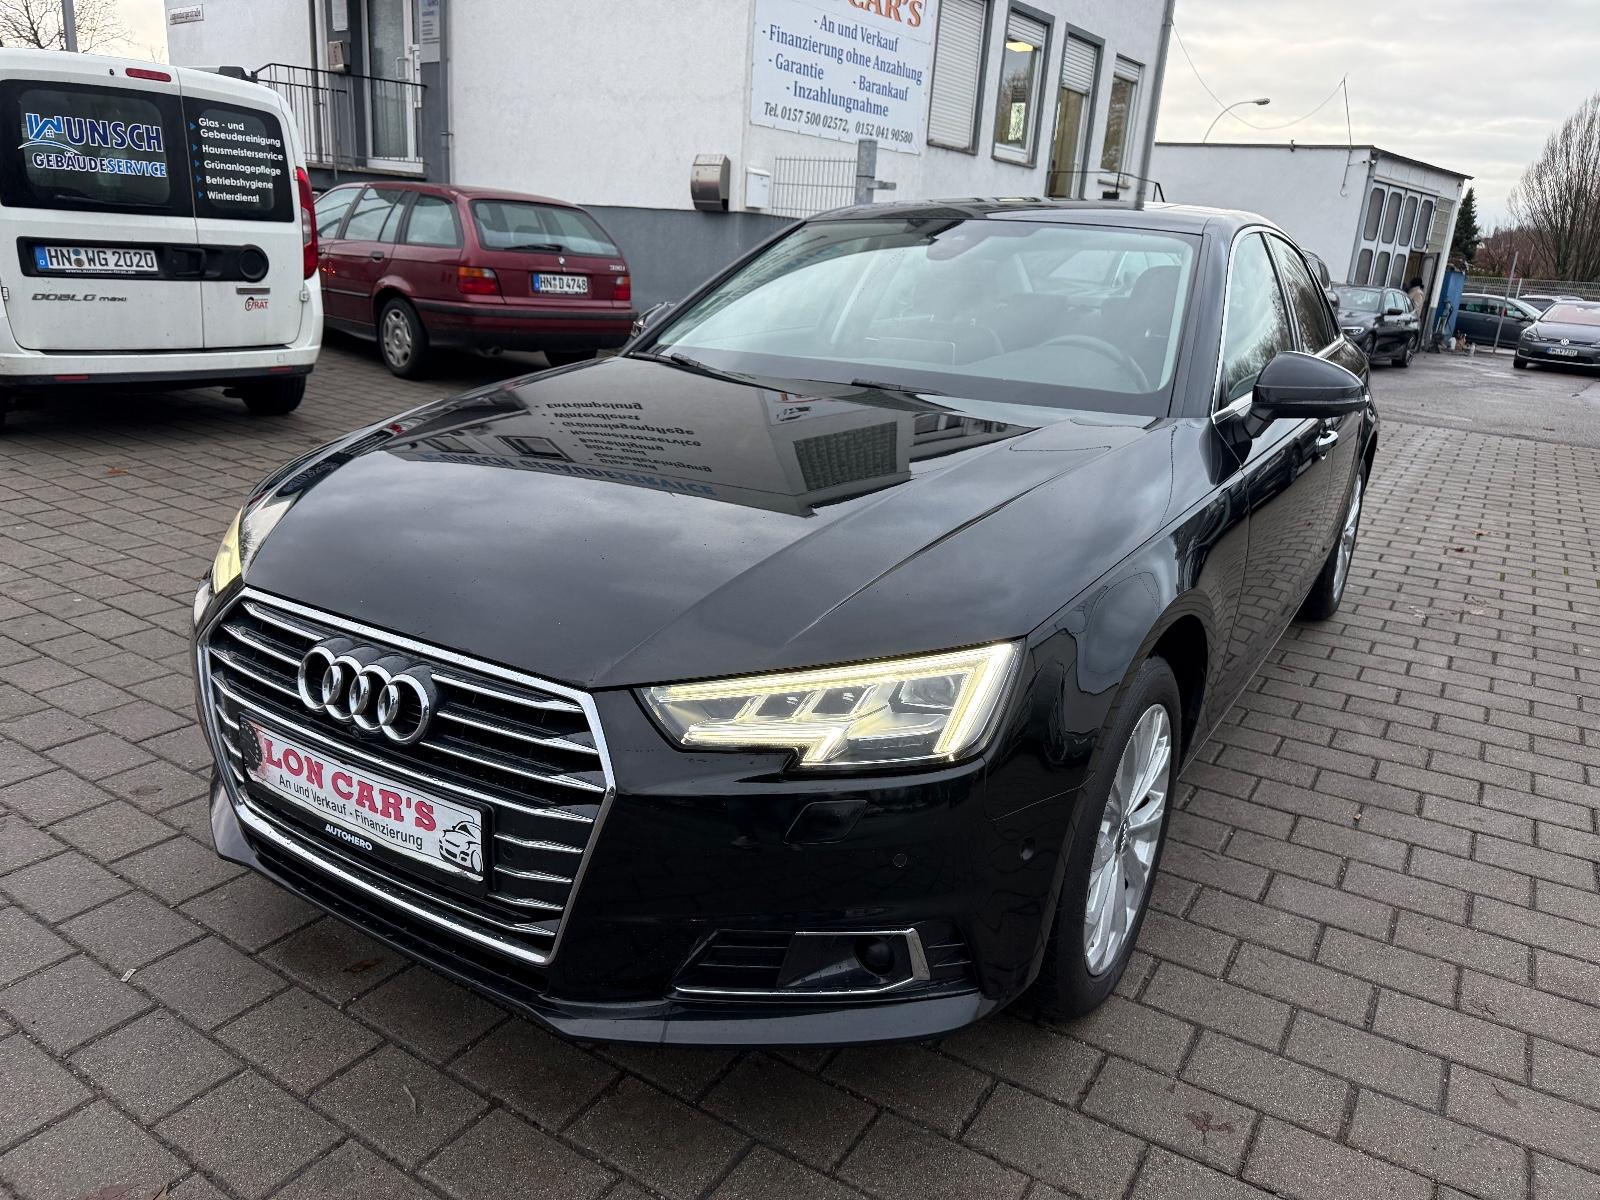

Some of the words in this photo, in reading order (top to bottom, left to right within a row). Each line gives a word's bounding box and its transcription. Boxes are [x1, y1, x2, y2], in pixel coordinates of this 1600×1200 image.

[819, 14, 835, 34] An
[837, 22, 858, 40] und
[860, 26, 899, 53] Verkauf
[769, 24, 844, 64] Finanzierung
[845, 48, 872, 68] ohne
[872, 55, 923, 86] Anzahlung
[775, 53, 824, 80] Garantie
[793, 80, 889, 117] Inzahlungnahme
[858, 75, 910, 101] Barankauf
[25, 113, 164, 152] WUNSCH
[198, 117, 220, 128] Glas
[227, 122, 245, 131] und
[780, 106, 804, 123] 0157
[805, 110, 821, 127] 500
[854, 120, 875, 137] 0152
[875, 126, 889, 140] 041
[890, 128, 913, 144] 90580
[200, 129, 281, 147] Gebeudereinigung
[32, 152, 167, 177] GEBÄUDESERVICE
[202, 144, 284, 160] Hausmeisterservice
[204, 160, 281, 176] Grünanlagepflege
[205, 175, 273, 189] Betriebshygiene
[207, 190, 260, 203] Winterdienst
[85, 249, 109, 267] WG
[112, 250, 155, 269] 2020
[263, 738, 323, 789] LON
[331, 771, 437, 832] CAR'S
[279, 773, 292, 790] An
[293, 780, 310, 799] und
[311, 787, 347, 817] Verkauf
[355, 810, 424, 850] Finanzierung
[325, 823, 373, 851] AUTOHERO
